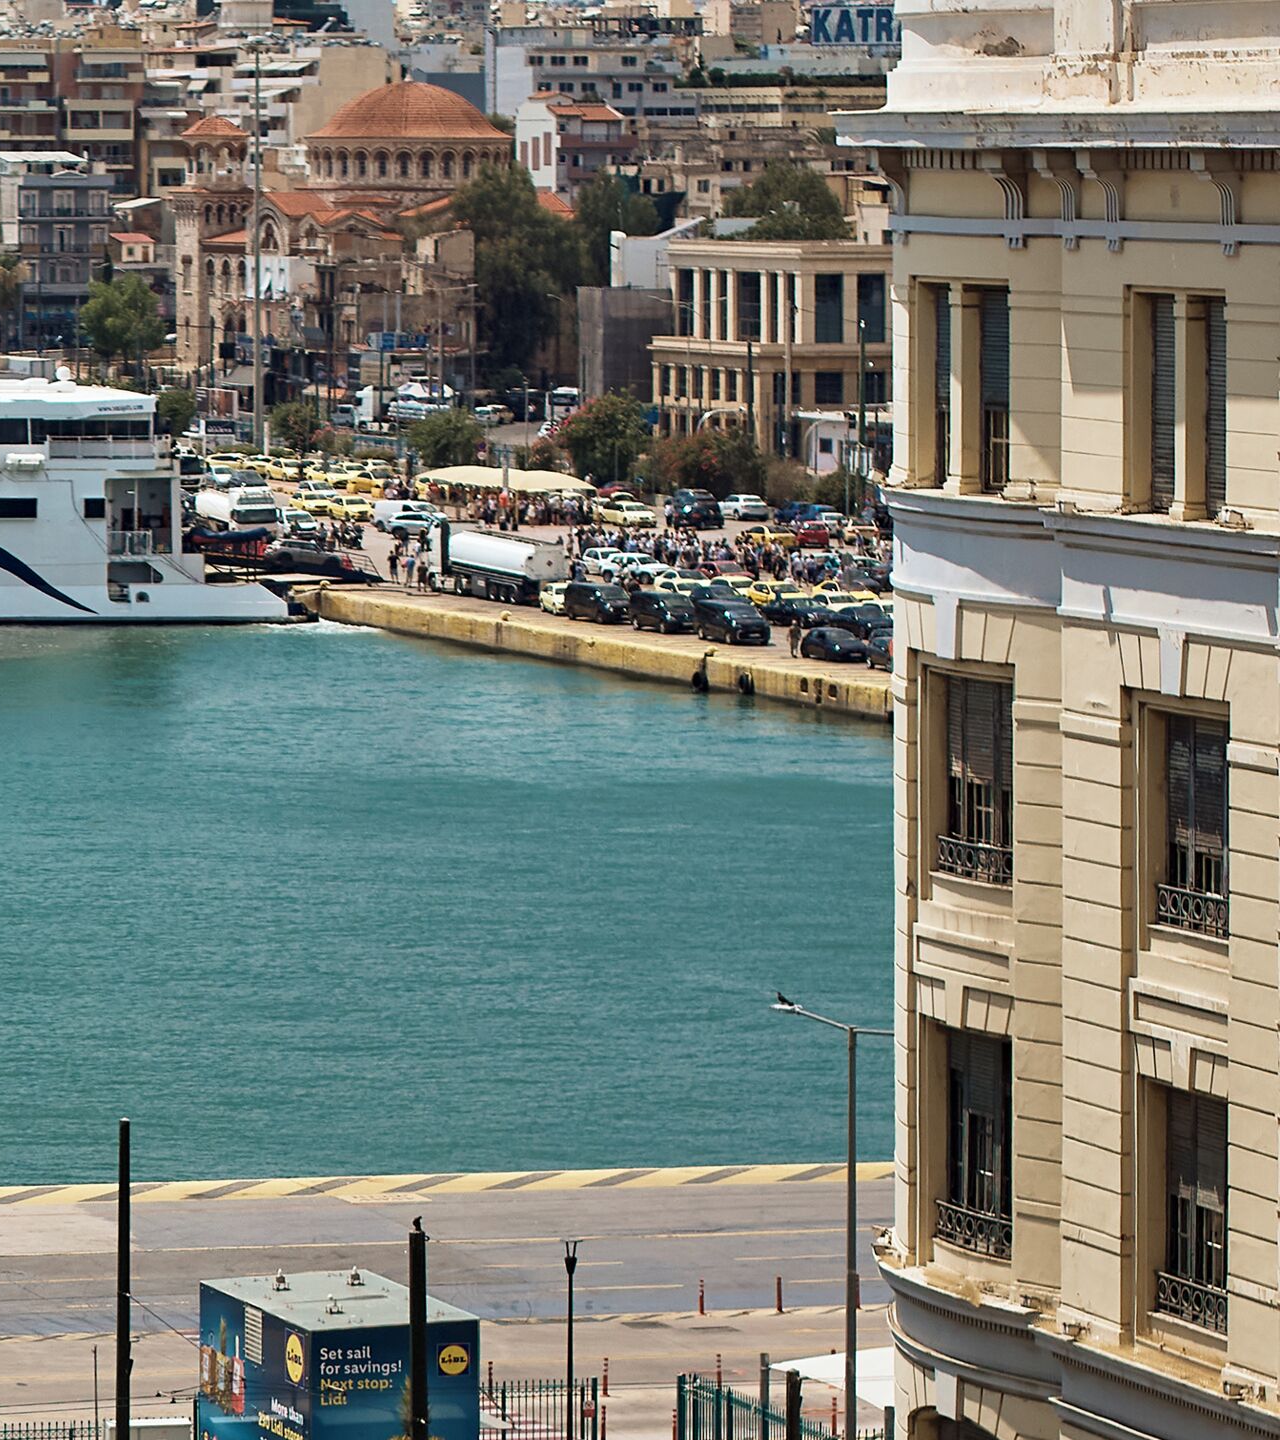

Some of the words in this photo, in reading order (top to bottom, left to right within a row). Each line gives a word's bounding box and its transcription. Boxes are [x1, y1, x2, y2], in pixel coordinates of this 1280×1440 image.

[320, 1347, 342, 1361] Set
[346, 1346, 371, 1360] sail
[320, 1363, 341, 1376] for
[344, 1360, 402, 1376] savings!
[320, 1377, 354, 1391] Next
[357, 1377, 393, 1392] stop:
[271, 1397, 288, 1419] More
[289, 1406, 304, 1425] than
[271, 1417, 283, 1437] Lidl
